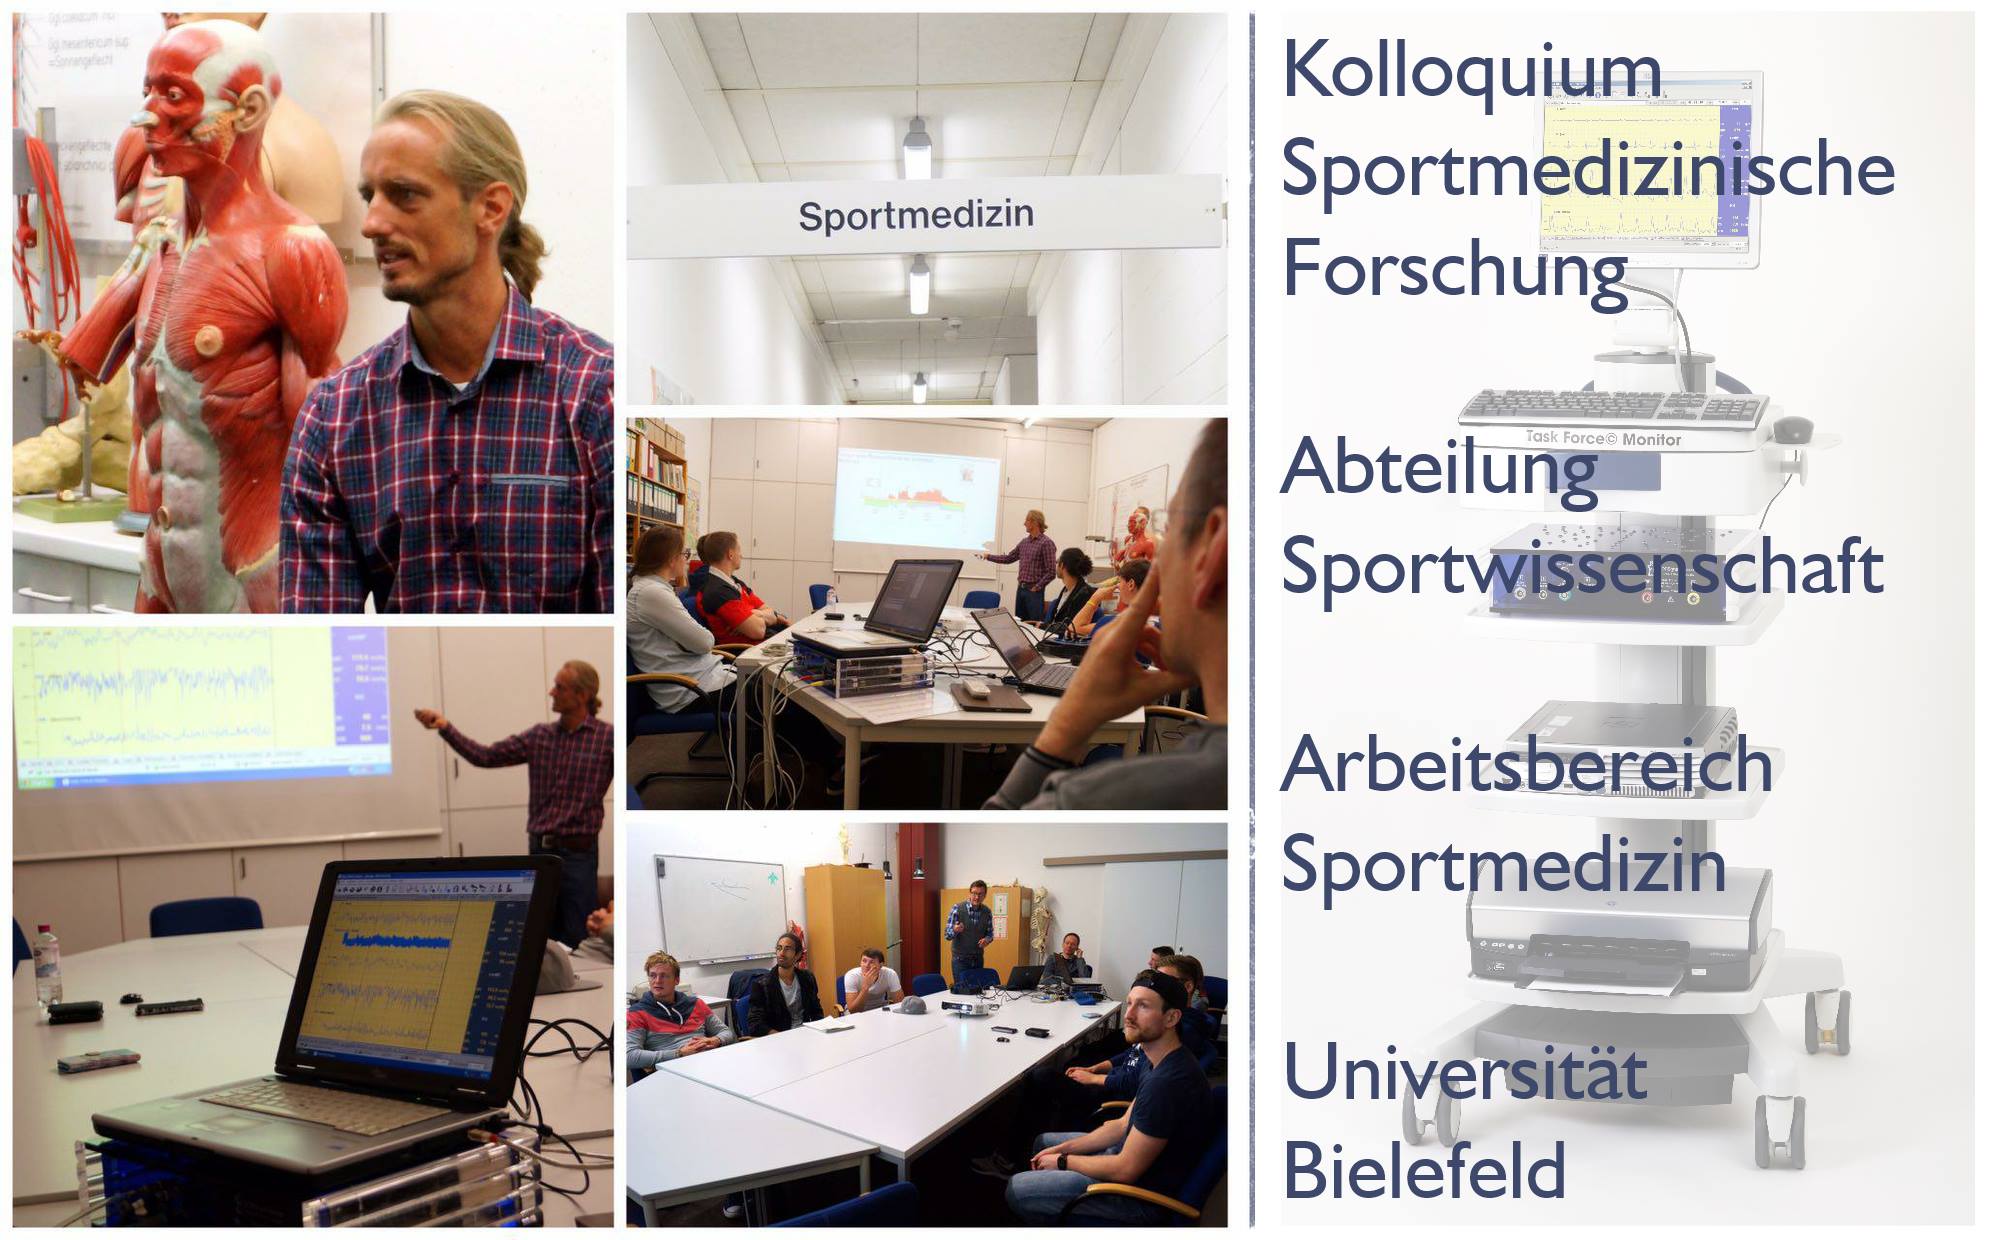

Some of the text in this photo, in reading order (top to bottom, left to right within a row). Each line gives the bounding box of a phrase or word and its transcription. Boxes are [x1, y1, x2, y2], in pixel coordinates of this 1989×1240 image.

[800, 198, 1034, 237] Sportmedizin
[1526, 429, 1558, 443] Task
[1623, 432, 1682, 446] Monitor
